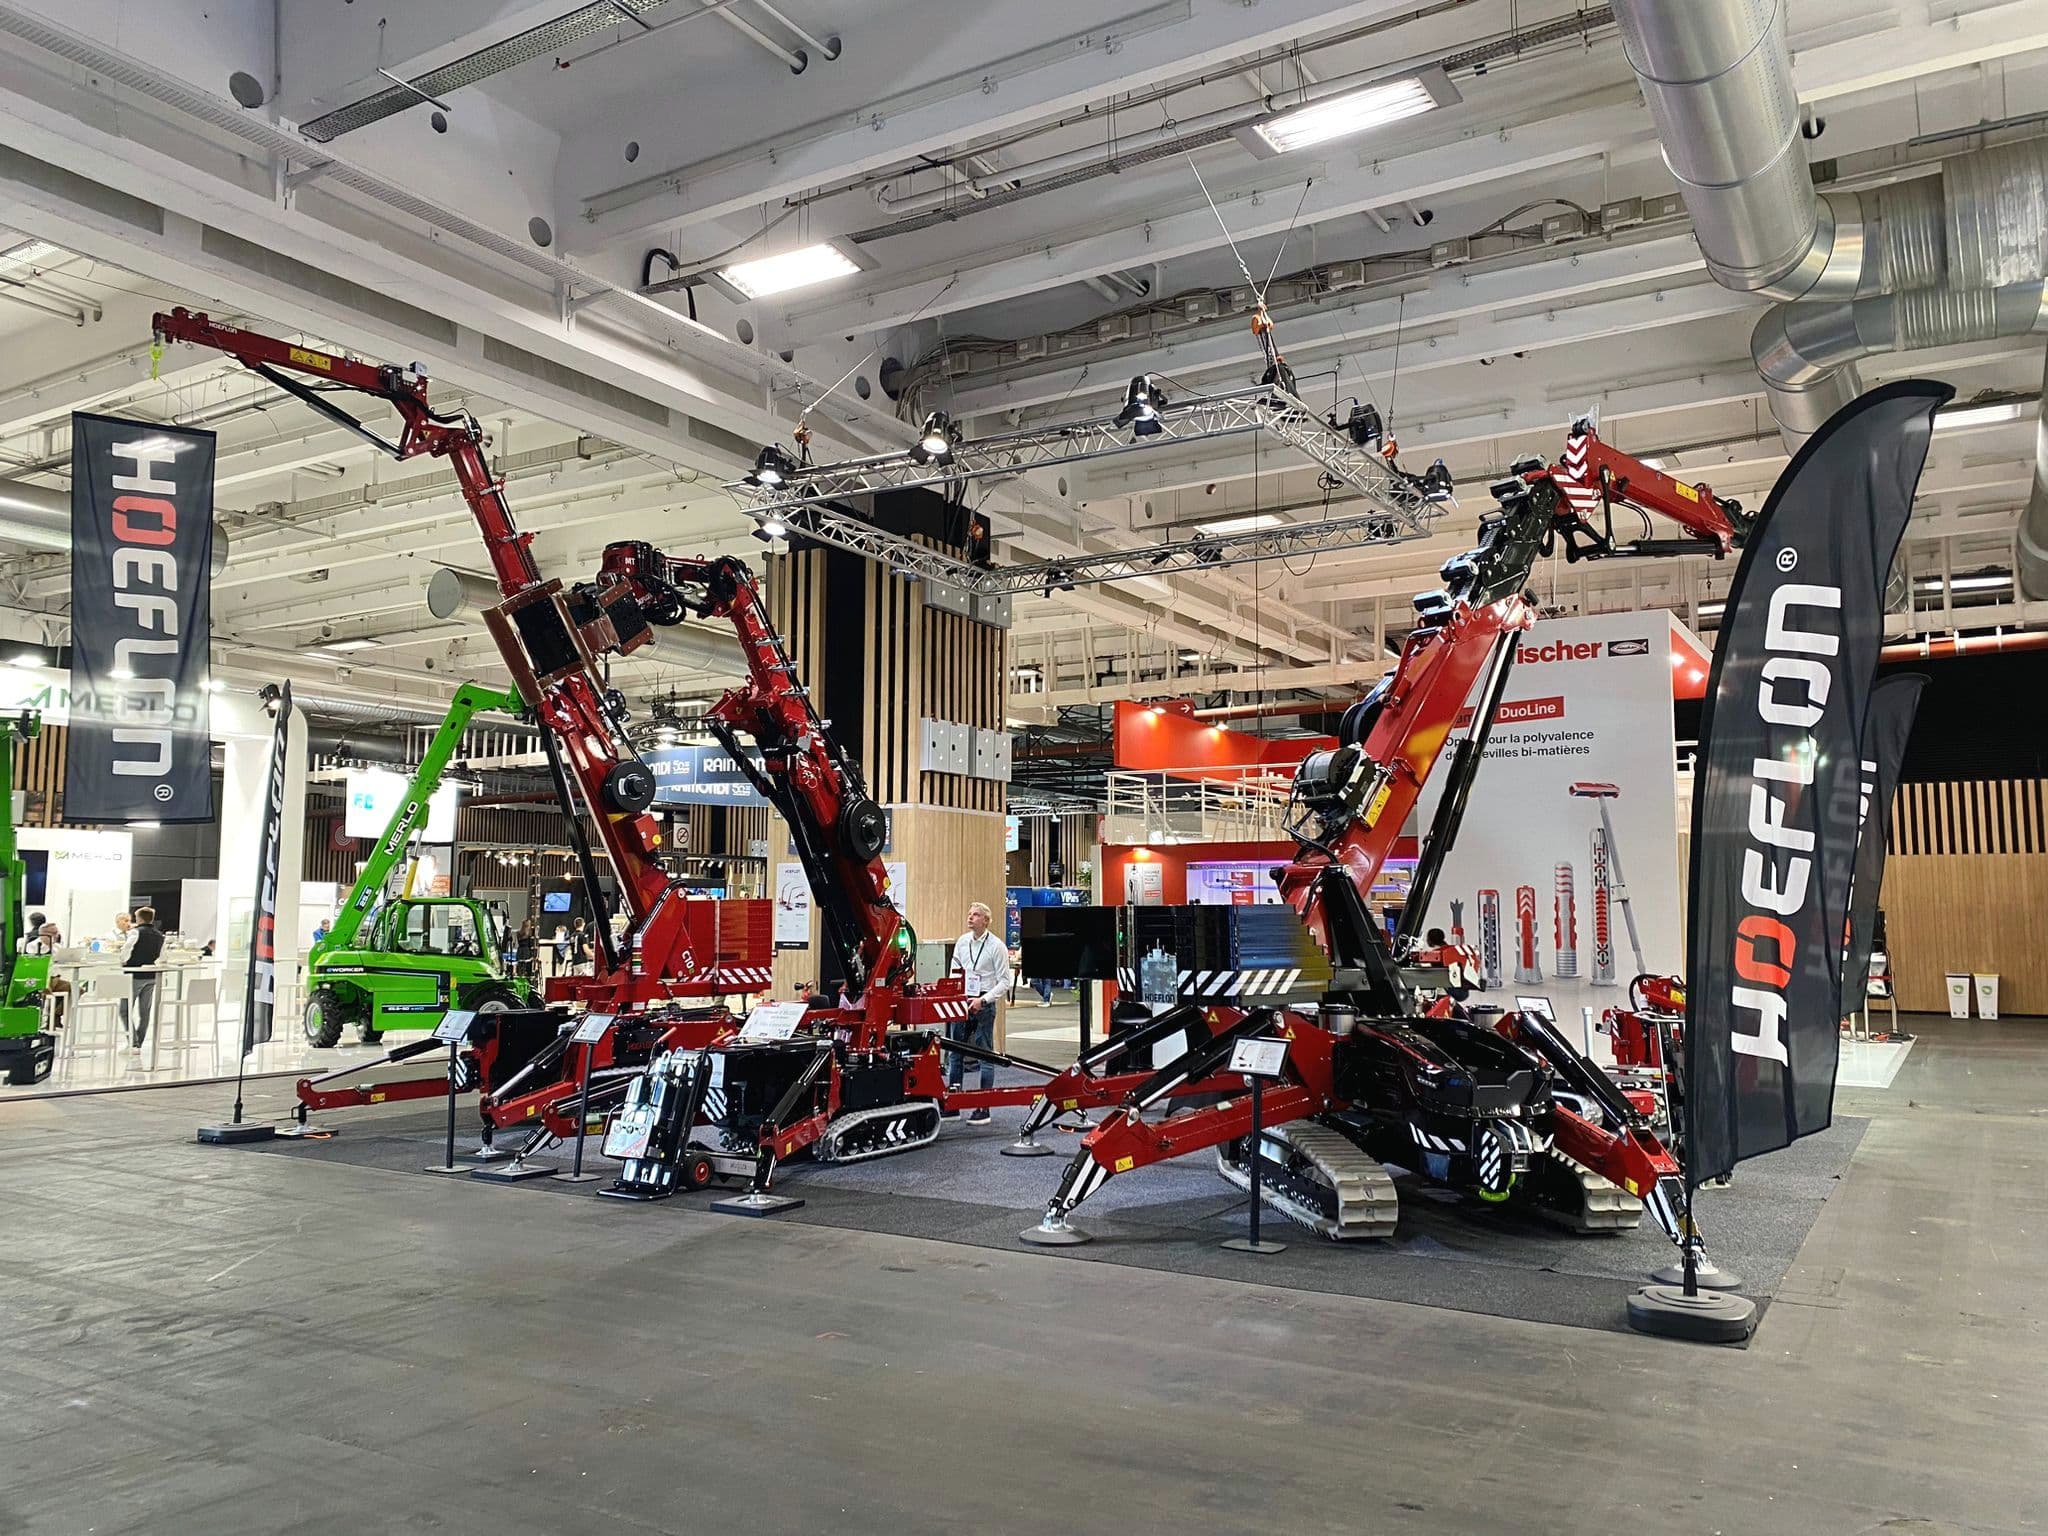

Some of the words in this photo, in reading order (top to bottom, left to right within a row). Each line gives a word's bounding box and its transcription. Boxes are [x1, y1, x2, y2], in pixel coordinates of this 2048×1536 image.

[1517, 640, 1603, 665] ischer
[1500, 704, 1557, 719] DuoLine
[1488, 734, 1508, 745] our
[1510, 733, 1521, 743] la
[1523, 730, 1594, 744] polyvalence
[1521, 745, 1590, 757] bi-matières
[384, 801, 418, 855] MERLO
